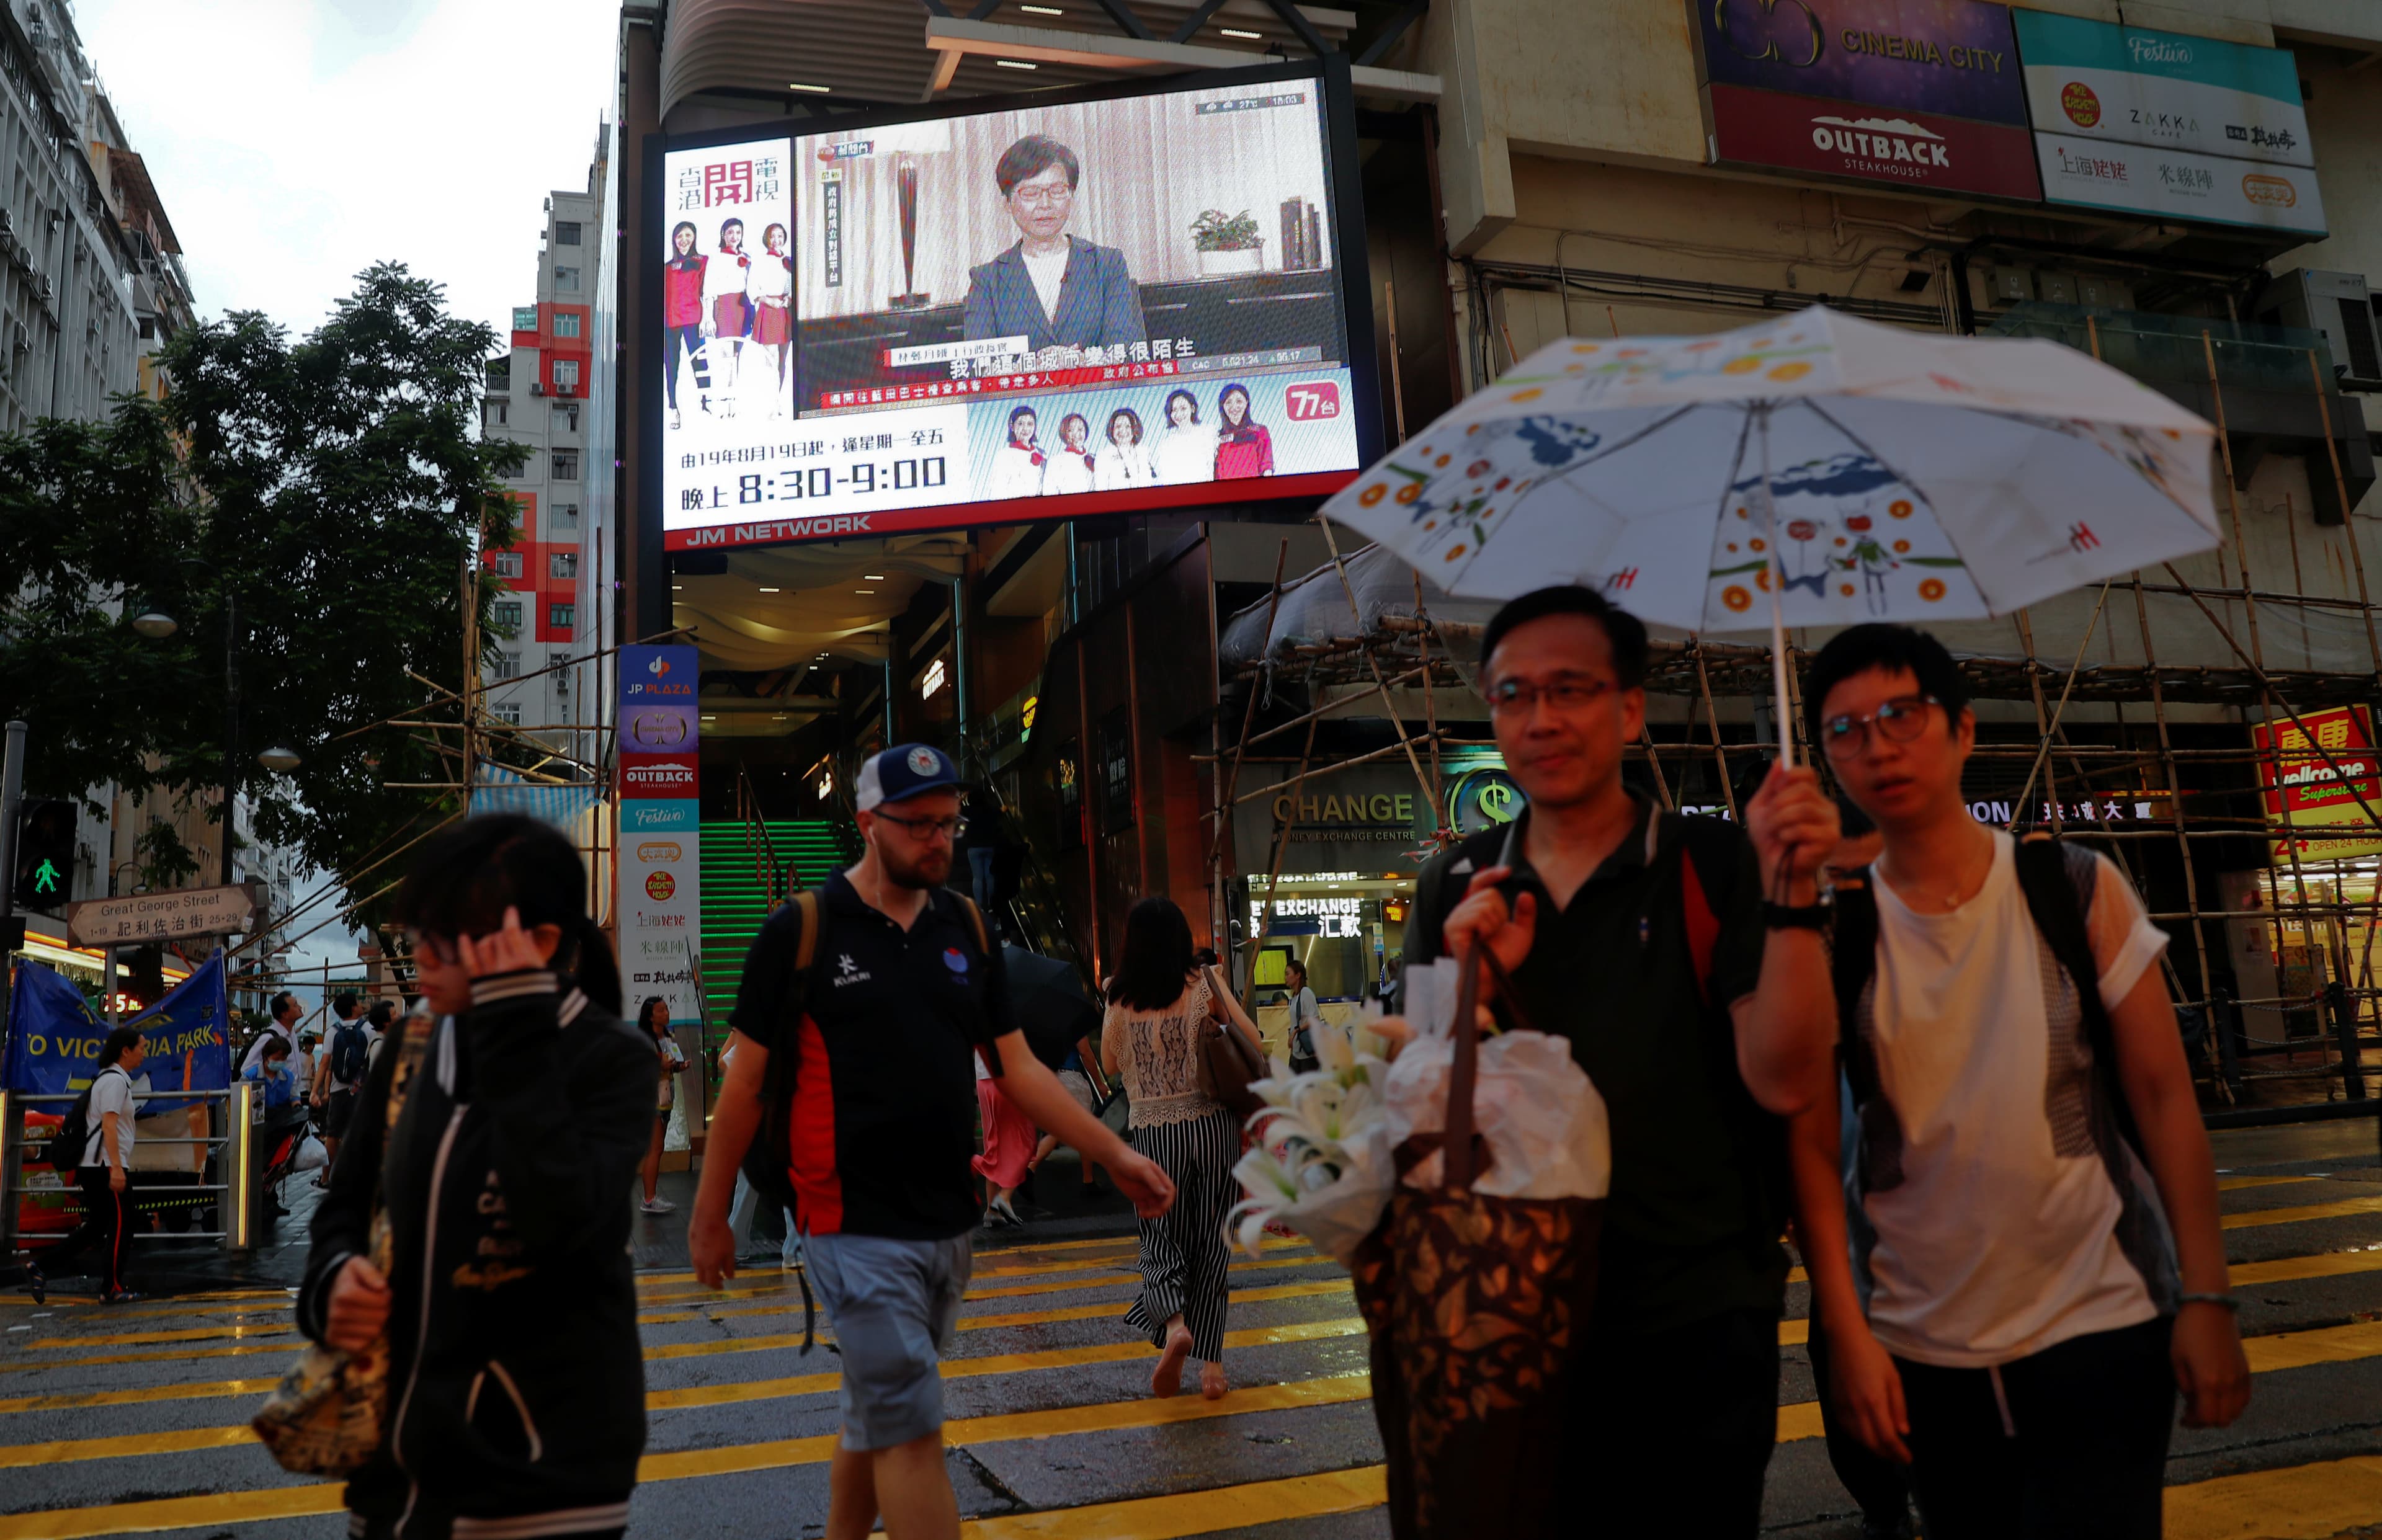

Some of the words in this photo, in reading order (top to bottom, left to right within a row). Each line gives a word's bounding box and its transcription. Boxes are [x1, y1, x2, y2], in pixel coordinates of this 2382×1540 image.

[1840, 29, 1943, 65] CINEMA
[1949, 45, 2003, 73] CITY
[2128, 37, 2193, 65] Festiva
[1813, 127, 1950, 168] OUTBACK
[1844, 158, 1922, 178] STEAKHOUSE
[2060, 154, 2129, 181] 上海姥姥
[682, 486, 729, 510] 晚上
[739, 456, 946, 505] 8:30-9:00
[686, 528, 725, 546] JM
[734, 515, 872, 541] NETWORK
[628, 683, 643, 695] JP
[646, 684, 692, 695] PLAZA
[626, 771, 694, 783] OUTBACK
[2299, 782, 2368, 803] Superstre
[635, 807, 685, 827] Festiva
[1316, 832, 1372, 842] EXCHANGE
[1376, 831, 1416, 840] CENTRE
[2312, 840, 2337, 852] OPEN
[2340, 839, 2352, 848] 24
[101, 904, 133, 917] Great
[138, 899, 179, 913] George
[183, 893, 220, 907] Street
[1275, 898, 1361, 917] EXCHANGE
[117, 915, 203, 937] 記利佐治街
[1318, 914, 1362, 938] 汇款
[56, 1036, 172, 1059] VICRIA
[176, 1023, 215, 1053] PARK
